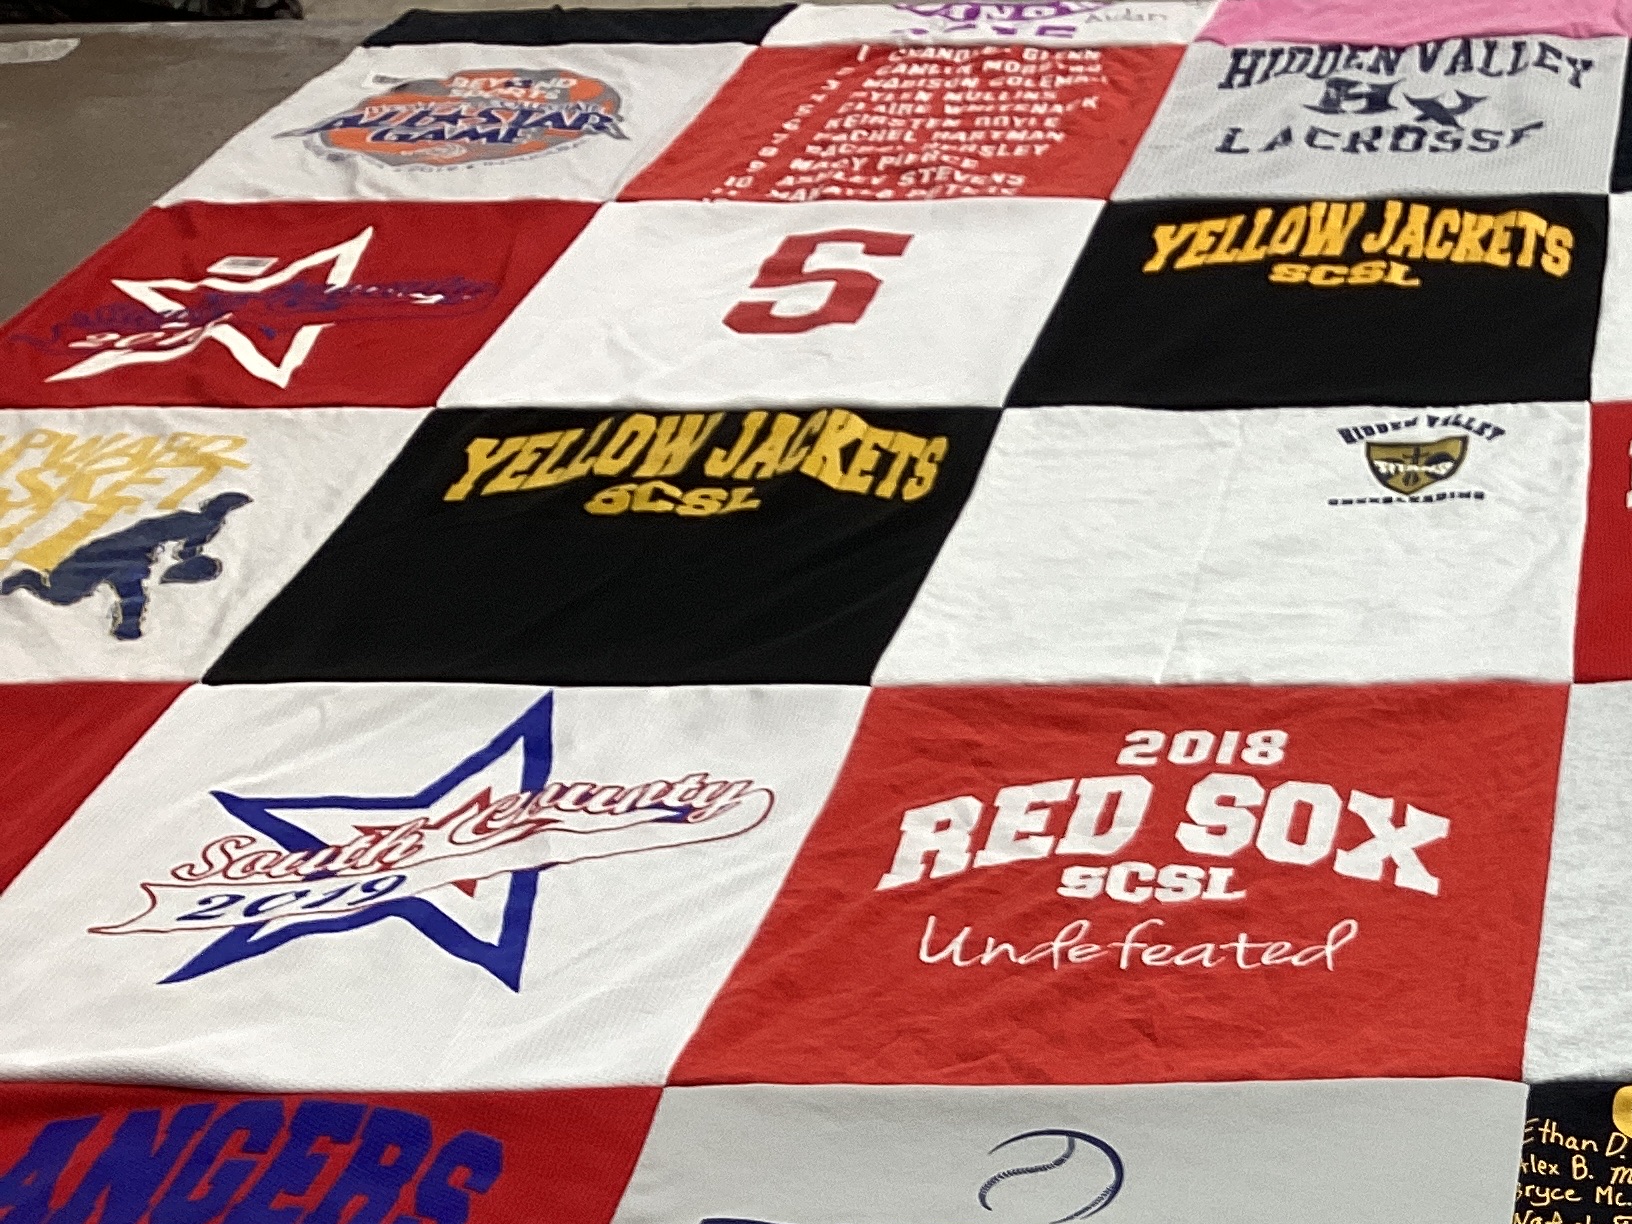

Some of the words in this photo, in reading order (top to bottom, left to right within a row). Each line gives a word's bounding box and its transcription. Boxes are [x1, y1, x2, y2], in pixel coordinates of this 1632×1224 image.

[1218, 44, 1400, 89] HIDDEN
[1418, 39, 1594, 88] VALLEY
[1142, 201, 1352, 272] YELLOW
[1364, 201, 1574, 277] JACKETS
[1268, 262, 1419, 287] SCSL
[443, 411, 724, 502] YELLOW
[704, 408, 948, 501] JACKETS
[584, 480, 761, 516] SCSL
[1116, 729, 1289, 767] 2018
[171, 817, 430, 881] South
[447, 774, 755, 847] County
[874, 774, 1155, 892] RED
[1175, 772, 1451, 896] SOX
[176, 873, 406, 921] 2019
[1057, 861, 1246, 903] SCSL
[917, 915, 1360, 973] Undefeated
